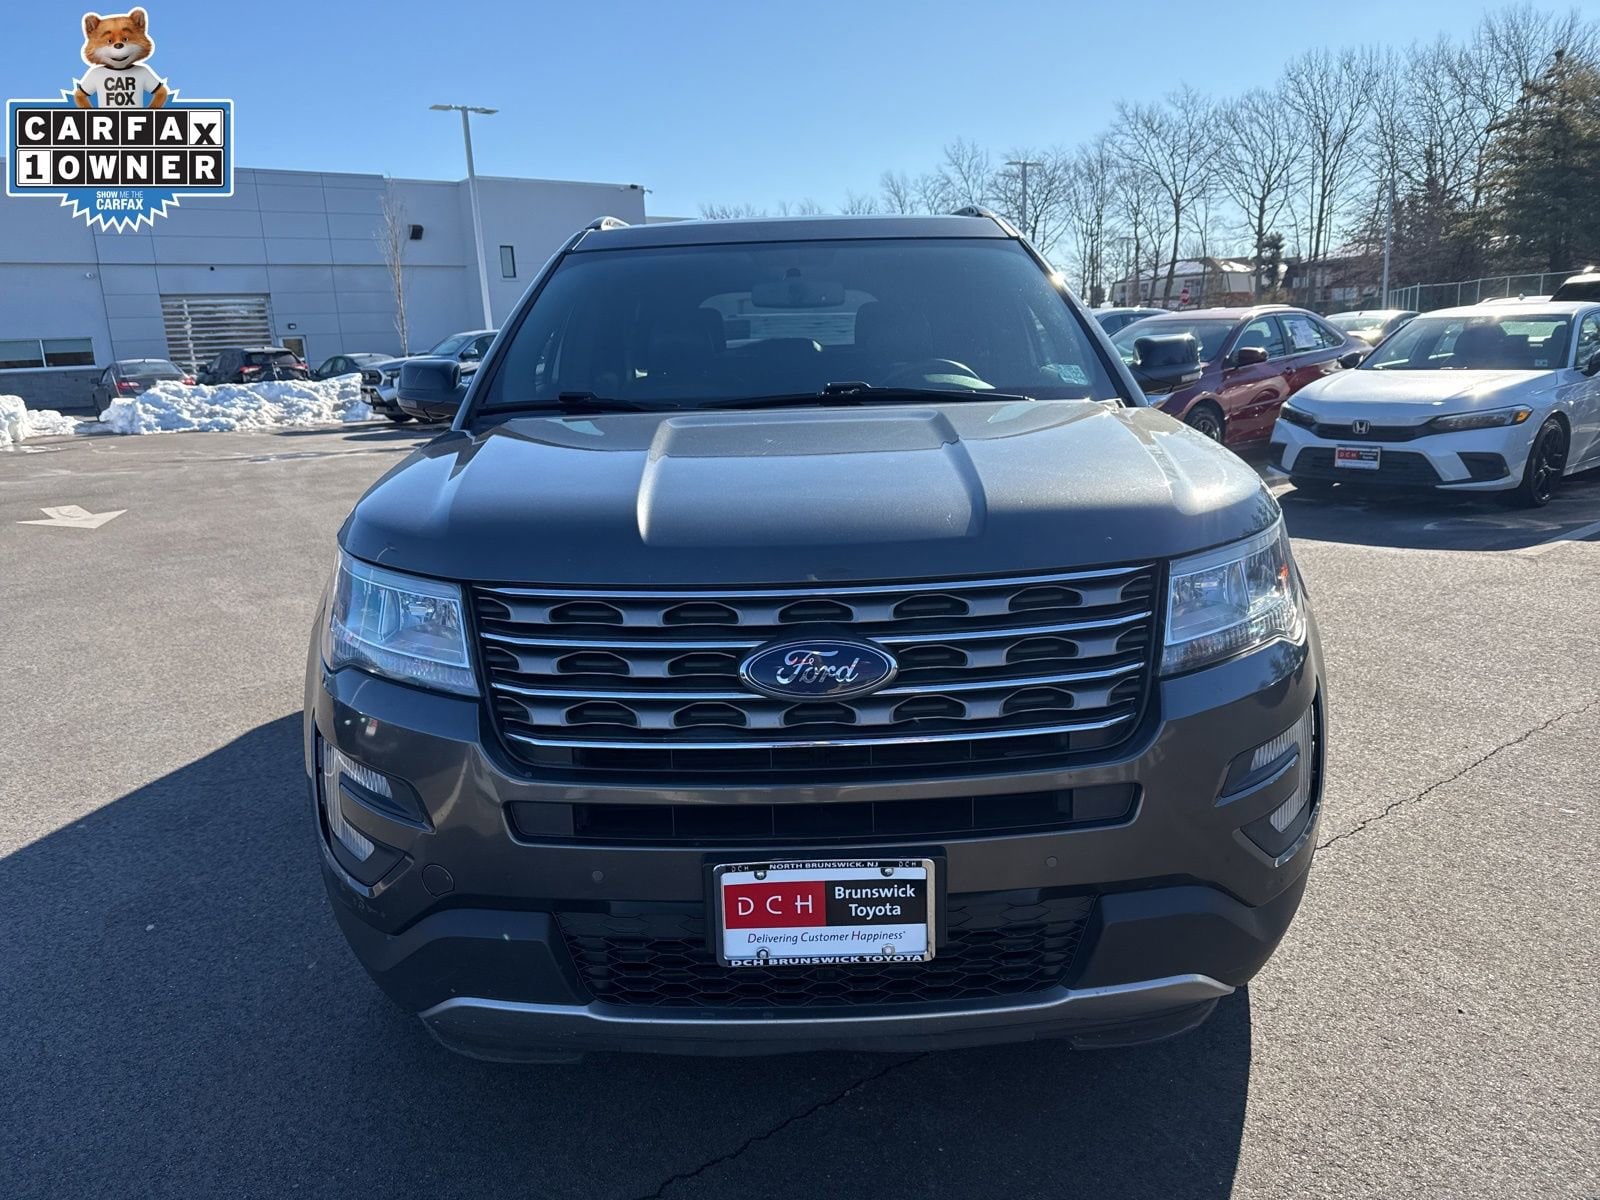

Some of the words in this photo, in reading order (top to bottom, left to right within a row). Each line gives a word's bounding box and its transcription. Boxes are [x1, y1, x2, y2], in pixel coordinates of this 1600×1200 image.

[775, 650, 860, 685] Ford
[834, 885, 916, 900] Brunswick
[849, 903, 902, 920] Toyota
[747, 933, 798, 945] Delivering
[800, 932, 849, 943] Customer
[768, 956, 860, 965] BRUNSWICK
[865, 954, 922, 962] TOYOTA
